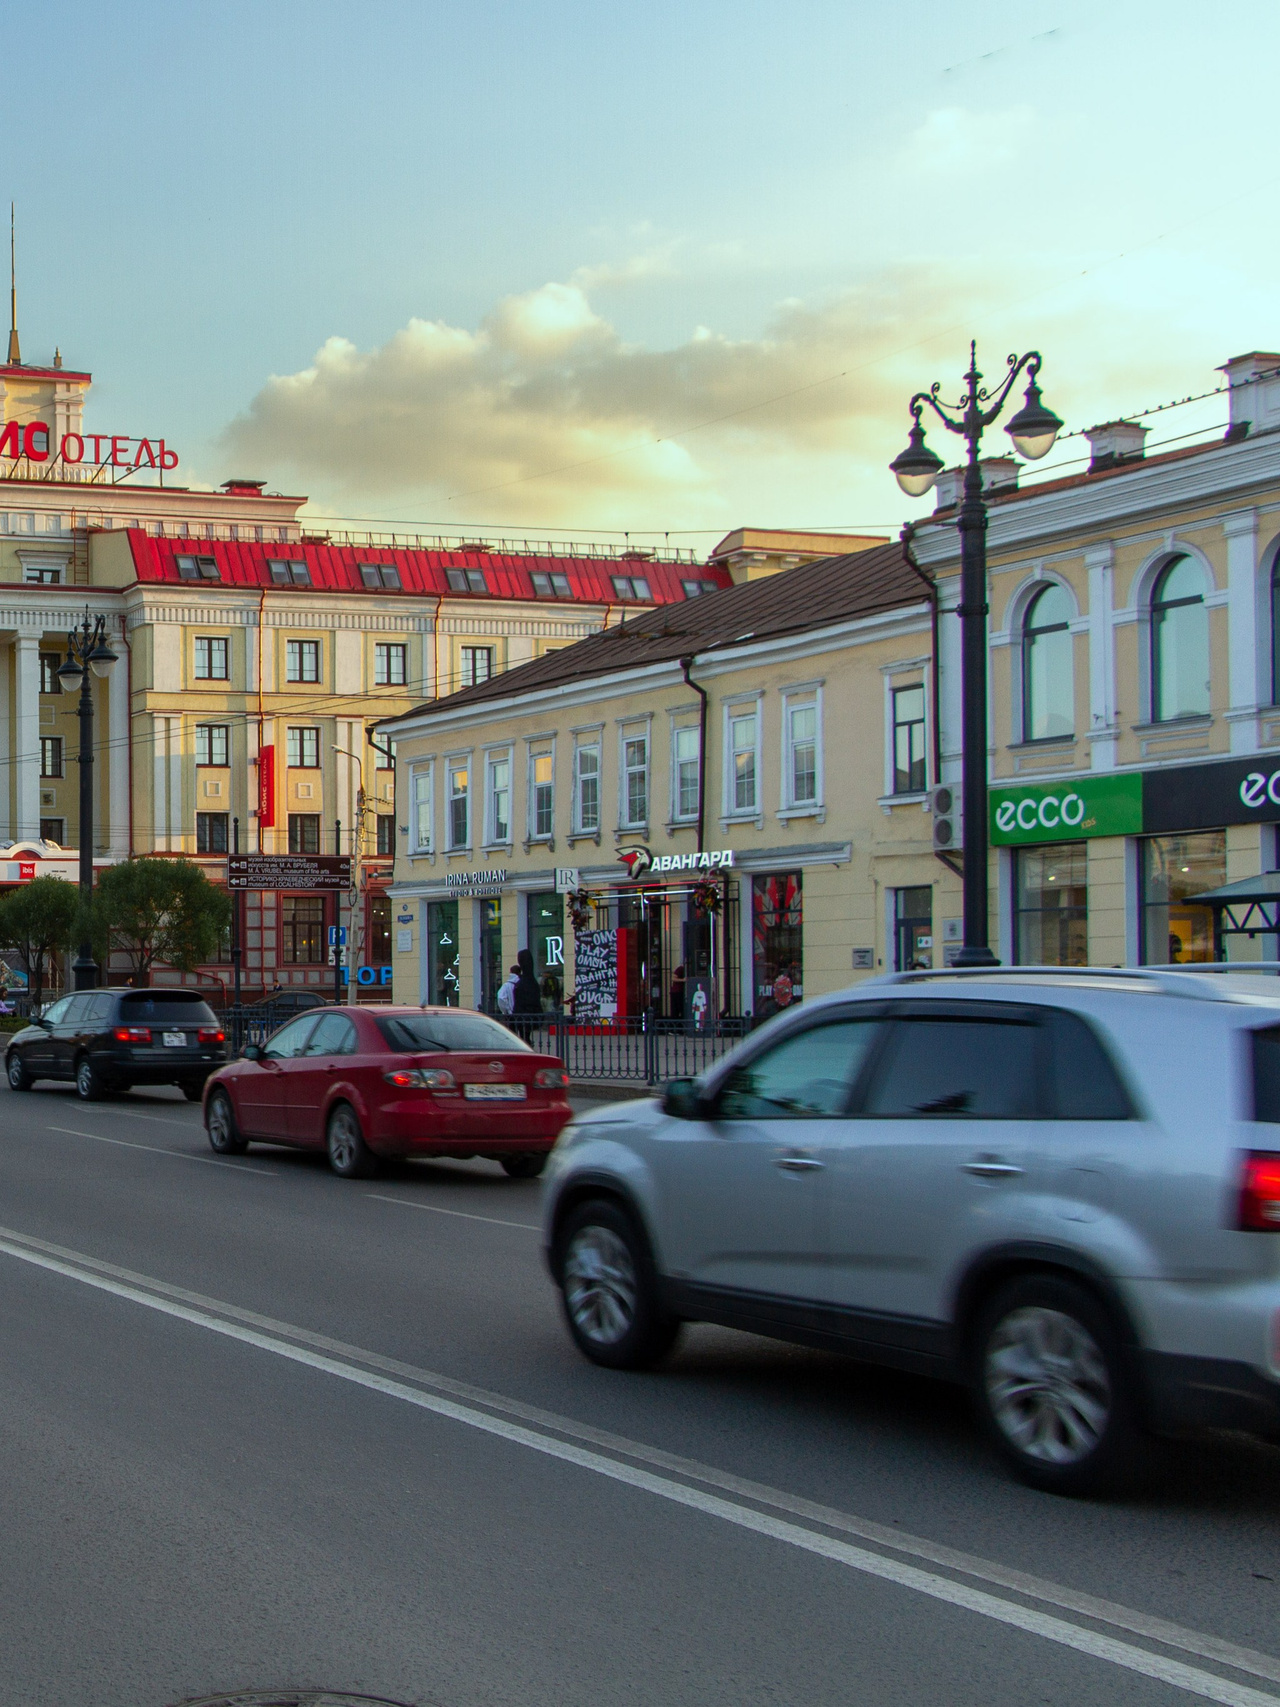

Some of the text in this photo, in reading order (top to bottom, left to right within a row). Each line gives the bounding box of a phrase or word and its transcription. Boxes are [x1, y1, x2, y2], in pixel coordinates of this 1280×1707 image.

[60, 432, 179, 470] ОТЕЛЬ
[995, 793, 1085, 832] ecco
[22, 866, 34, 874] ibis
[650, 849, 734, 872] АВАНГАРД
[445, 869, 507, 887] IRINA RUMAN
[580, 943, 609, 958] PLAY
